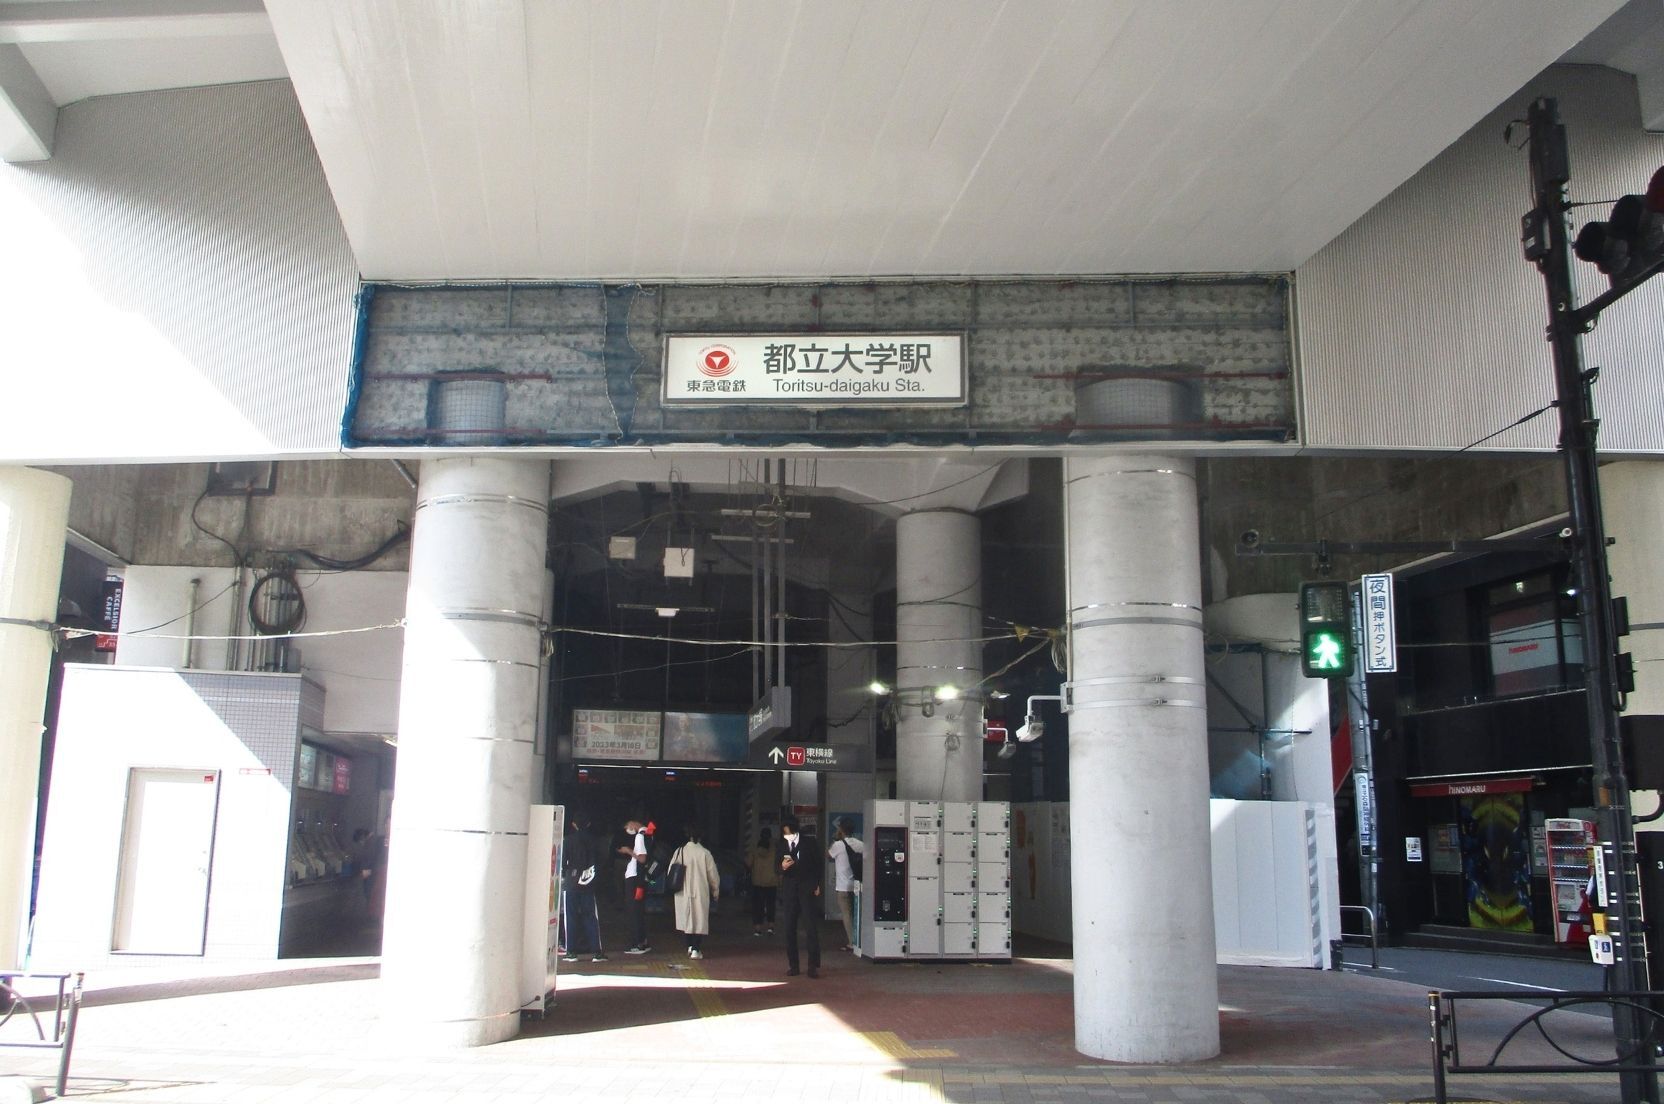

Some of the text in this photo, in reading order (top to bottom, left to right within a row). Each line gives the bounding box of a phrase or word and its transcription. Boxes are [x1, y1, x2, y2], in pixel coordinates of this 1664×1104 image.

[763, 343, 932, 374] 都立大学駅
[687, 379, 746, 392] 東急電鉄
[773, 378, 925, 395] Toritsu-daigaku Sta.
[111, 588, 121, 629] EXCELSIOR
[1369, 579, 1387, 667] 夜間押ボタン式
[790, 752, 802, 760] TY
[806, 747, 833, 758] 東横線
